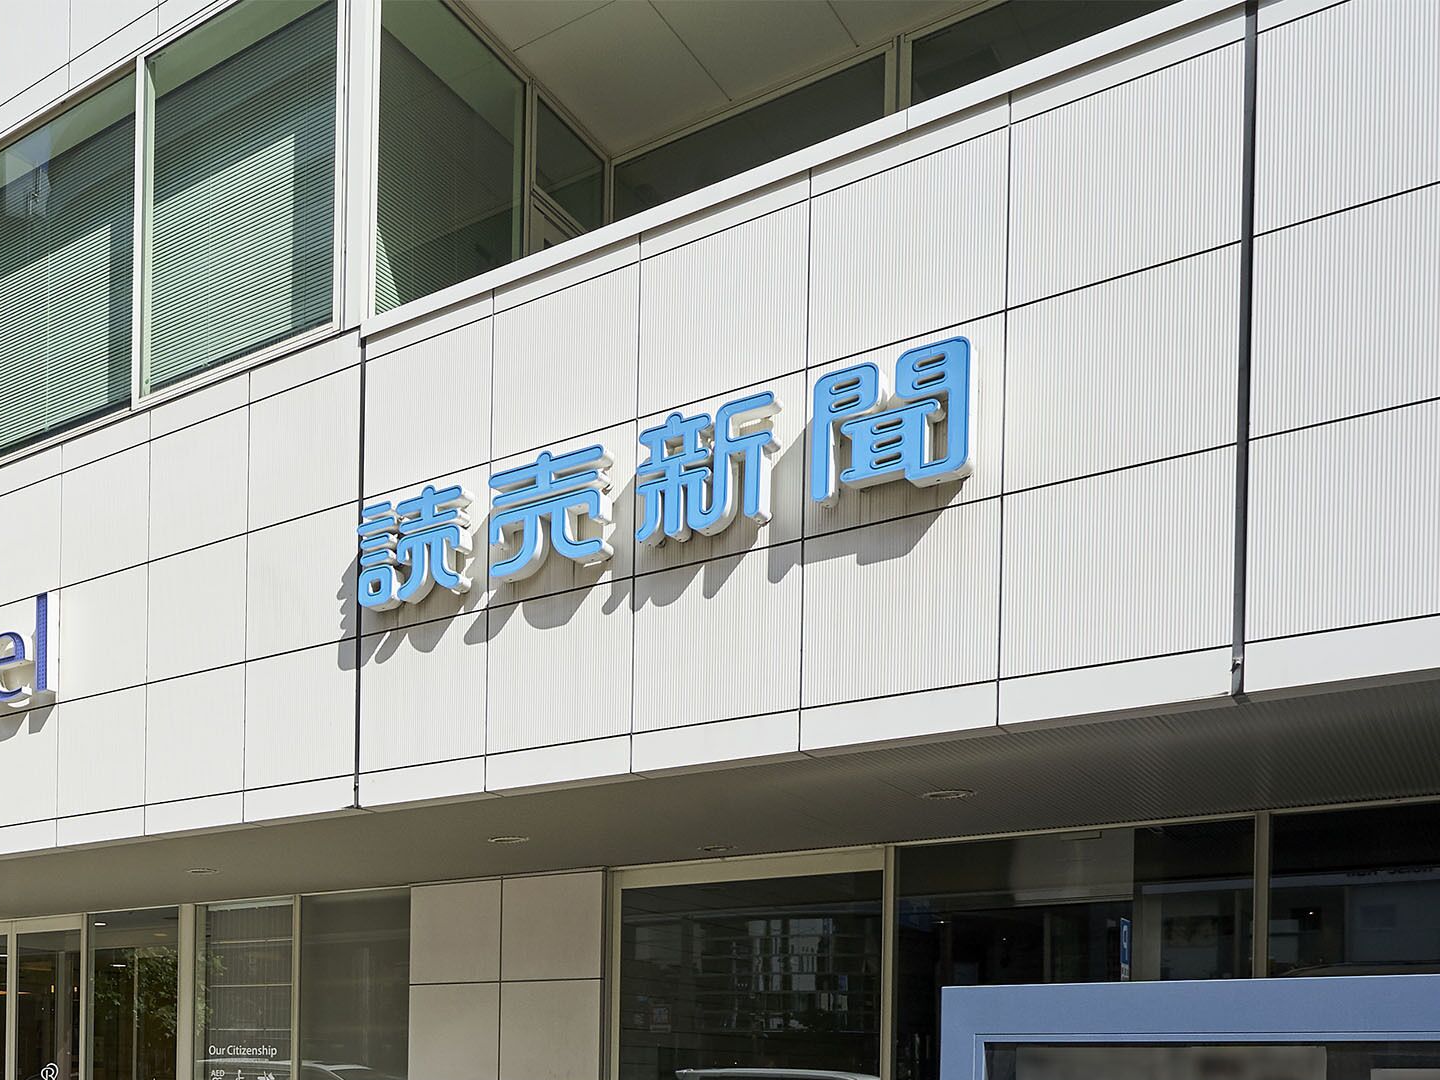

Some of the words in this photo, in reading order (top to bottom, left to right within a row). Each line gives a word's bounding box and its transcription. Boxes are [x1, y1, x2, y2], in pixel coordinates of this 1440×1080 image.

[357, 335, 973, 612] 読売新聞
[208, 1045, 226, 1056] Our
[226, 1045, 278, 1058] Citizenship
[210, 1069, 225, 1077] AED
